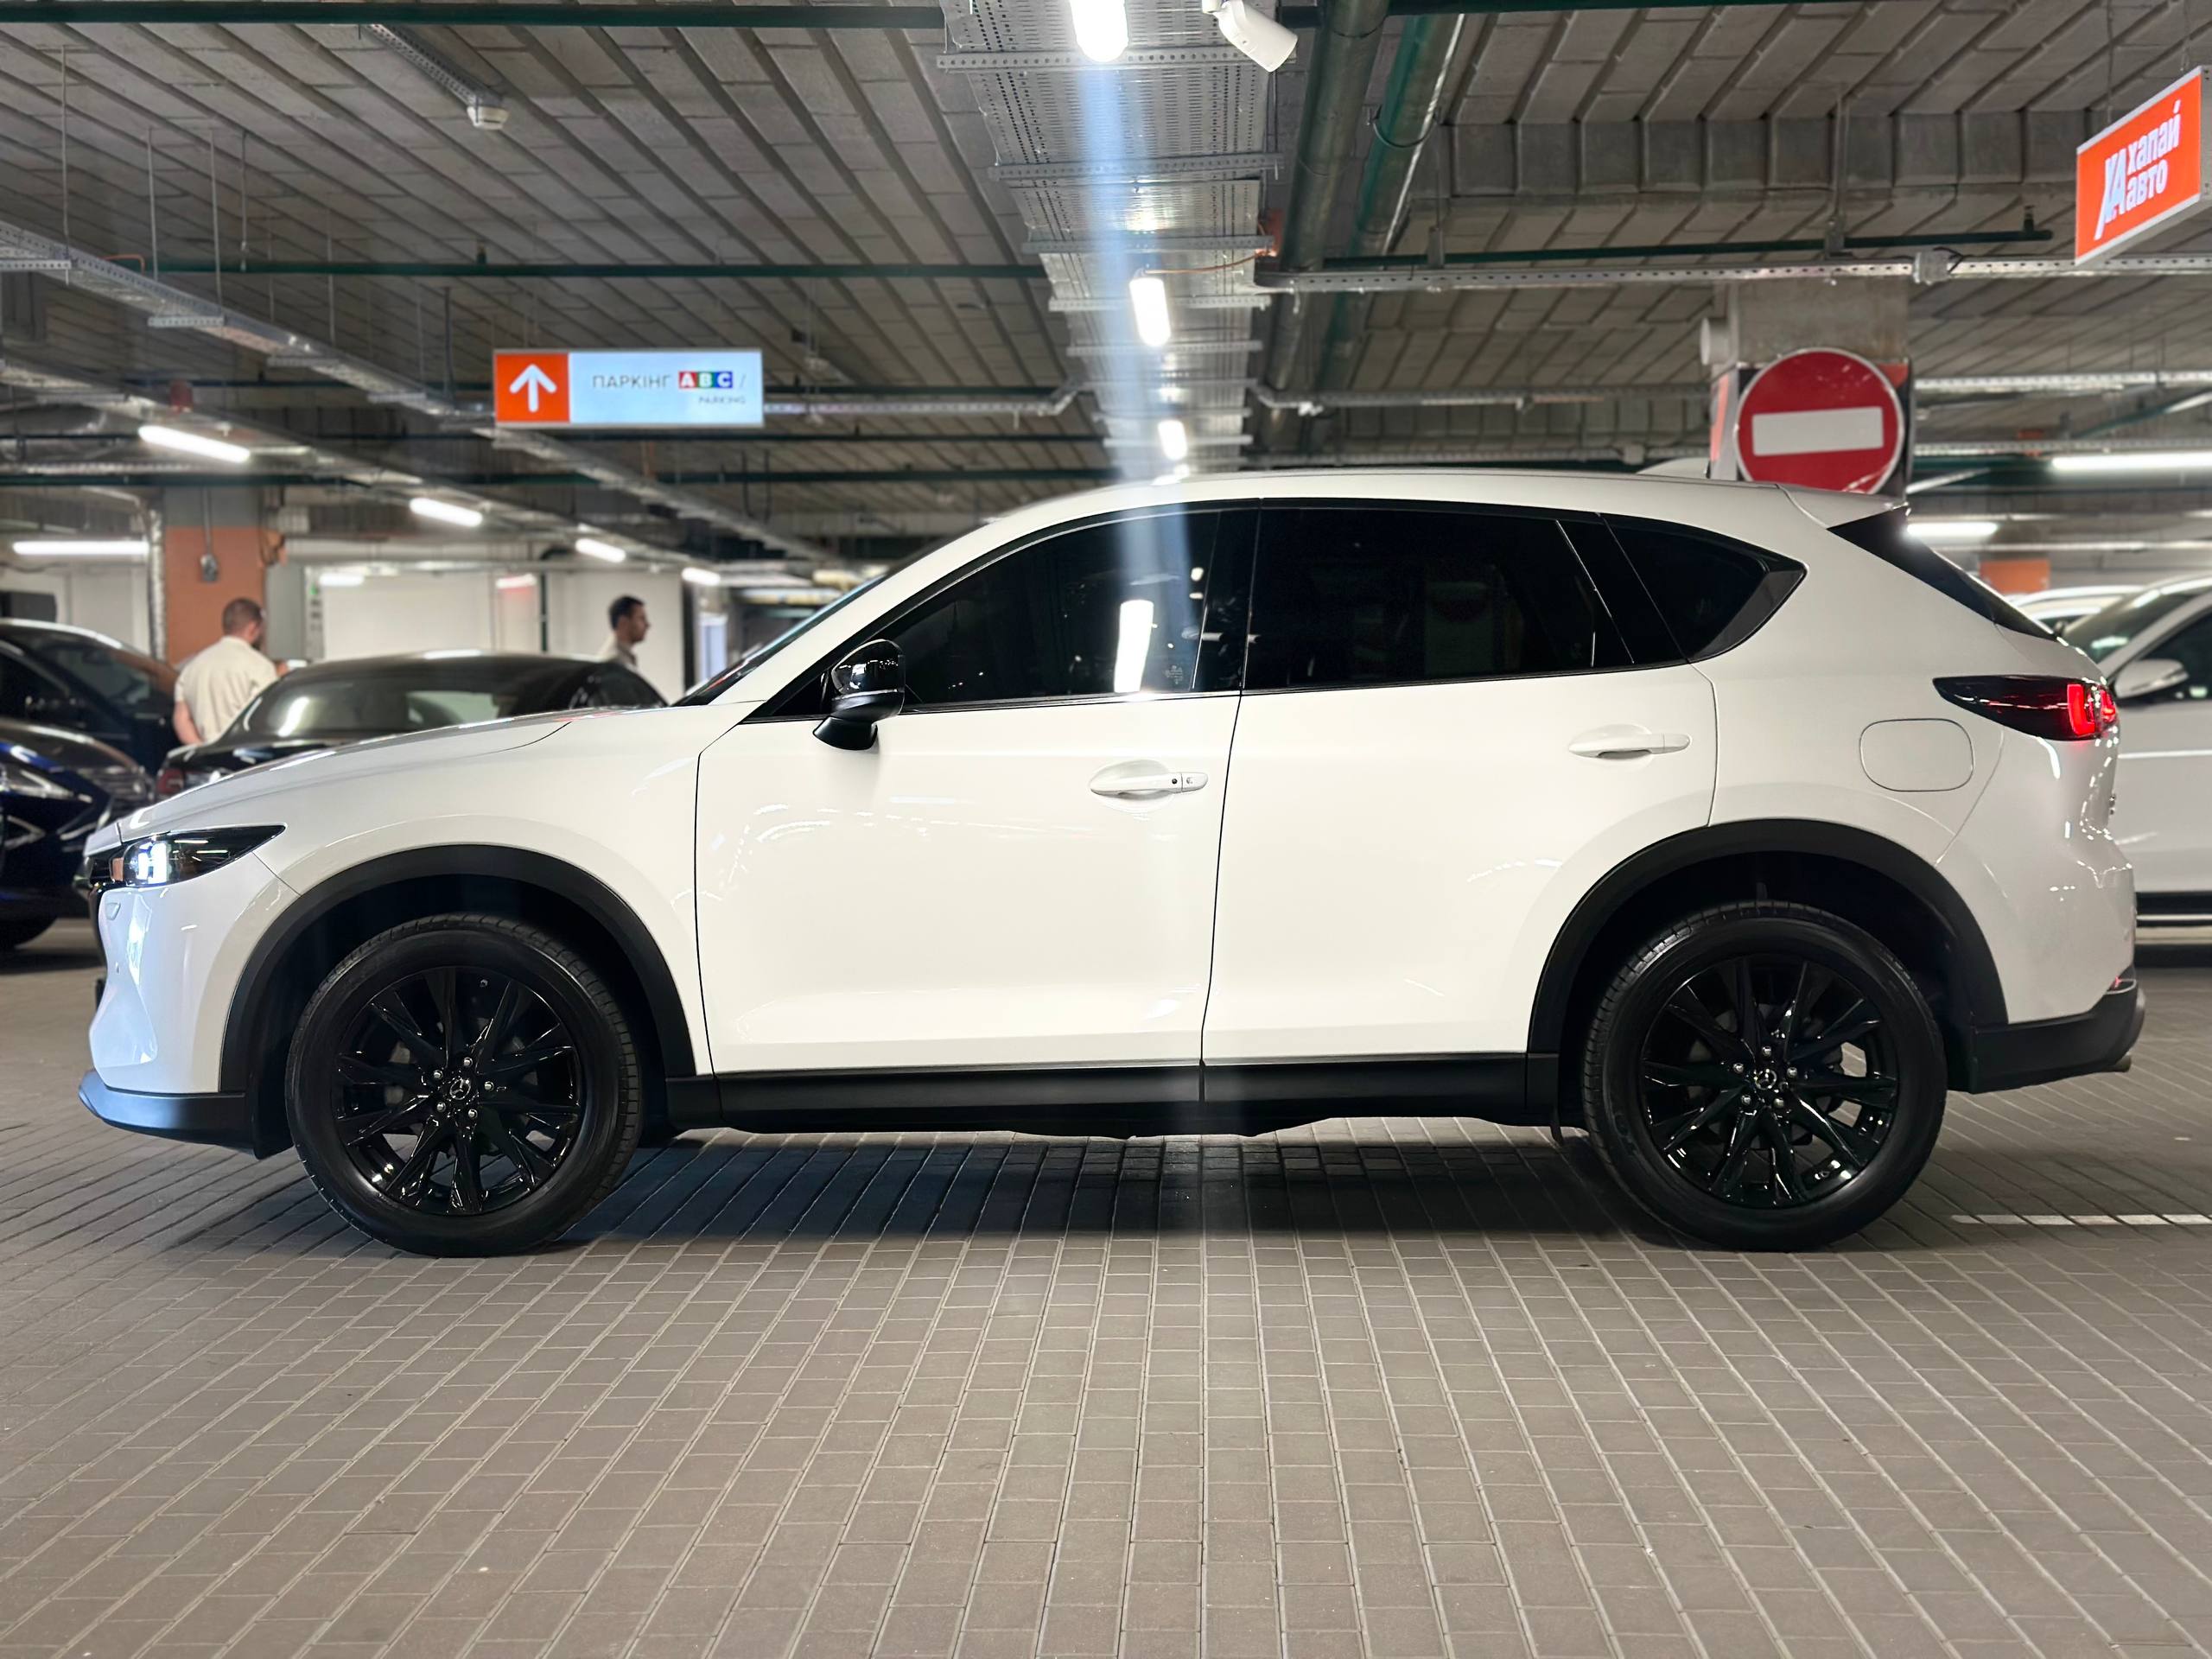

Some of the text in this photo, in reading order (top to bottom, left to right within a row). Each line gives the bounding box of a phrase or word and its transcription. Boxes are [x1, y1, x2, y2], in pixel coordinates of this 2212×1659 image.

[2127, 99, 2181, 175] хапай
[2126, 159, 2168, 211] авто
[592, 374, 671, 388] ПАРКІНГ
